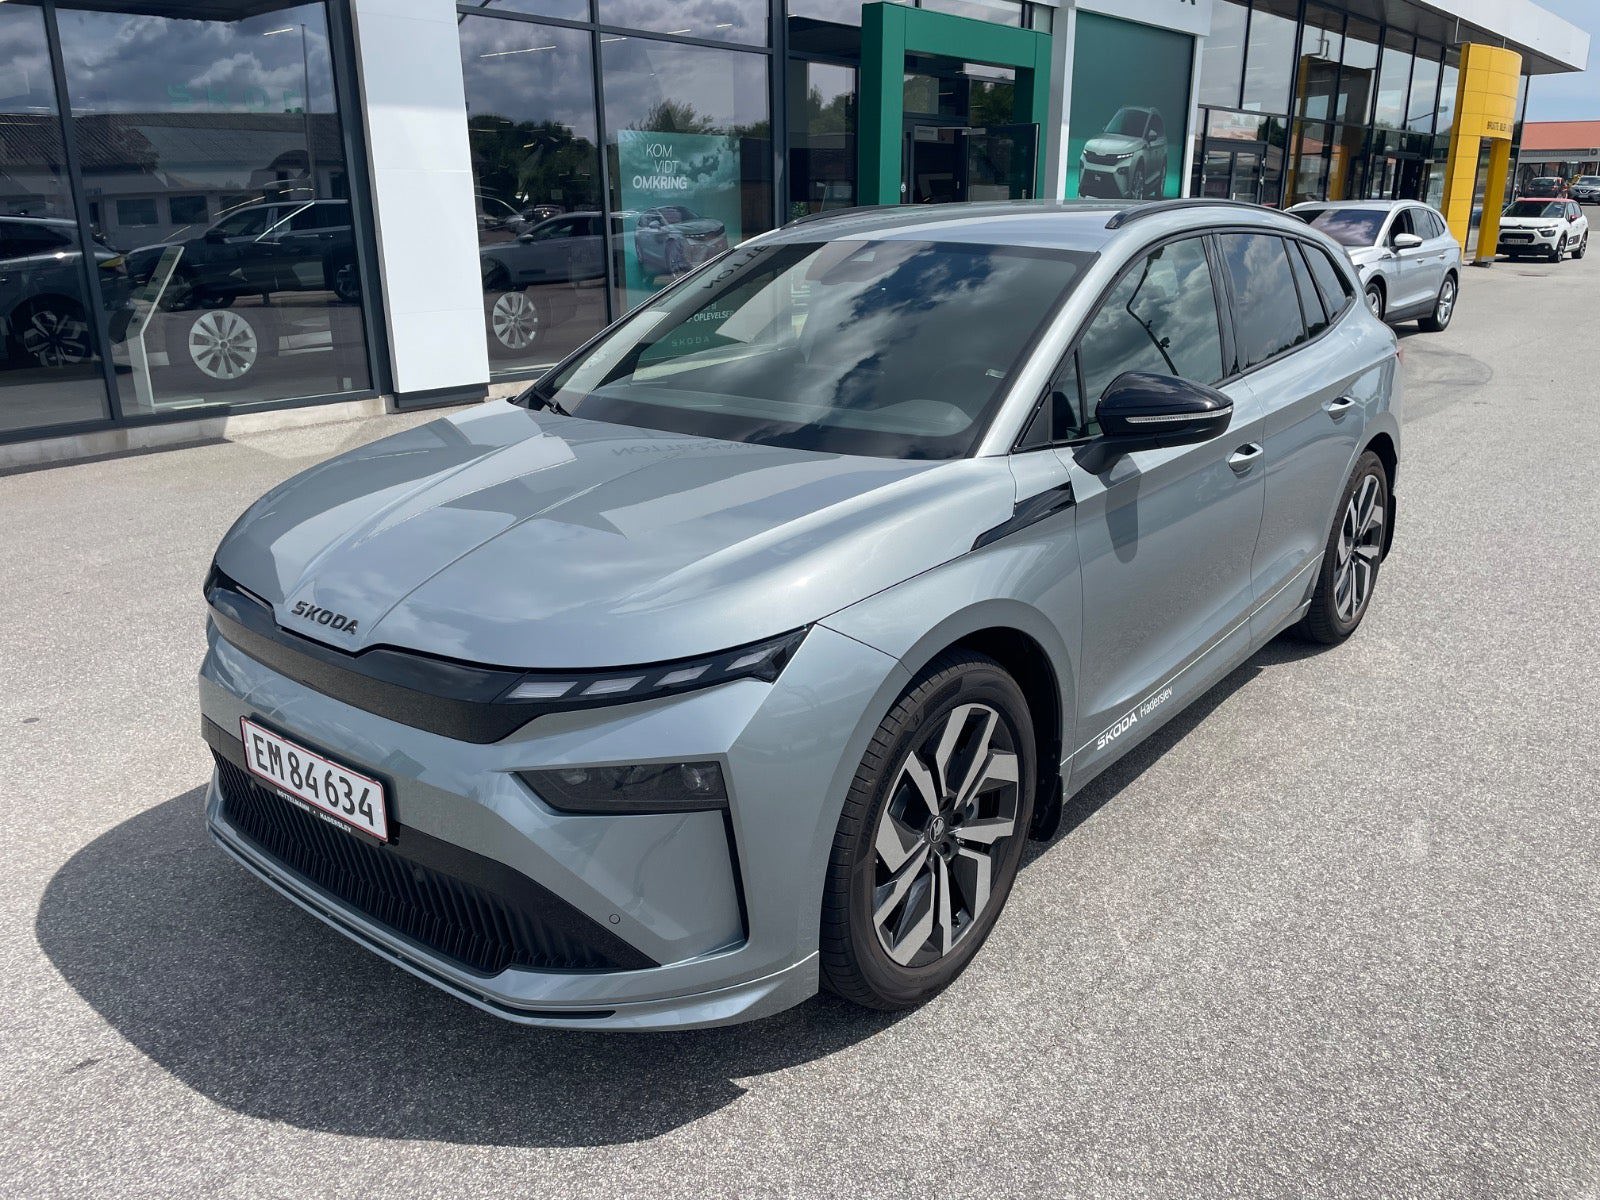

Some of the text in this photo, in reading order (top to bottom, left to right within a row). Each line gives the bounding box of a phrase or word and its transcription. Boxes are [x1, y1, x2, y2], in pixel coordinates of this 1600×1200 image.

[646, 143, 672, 158] KOM
[655, 160, 679, 174] VIDT
[632, 175, 688, 190] OMKRING
[291, 600, 359, 635] SKODA
[1097, 686, 1173, 750] SKODA Haderslev
